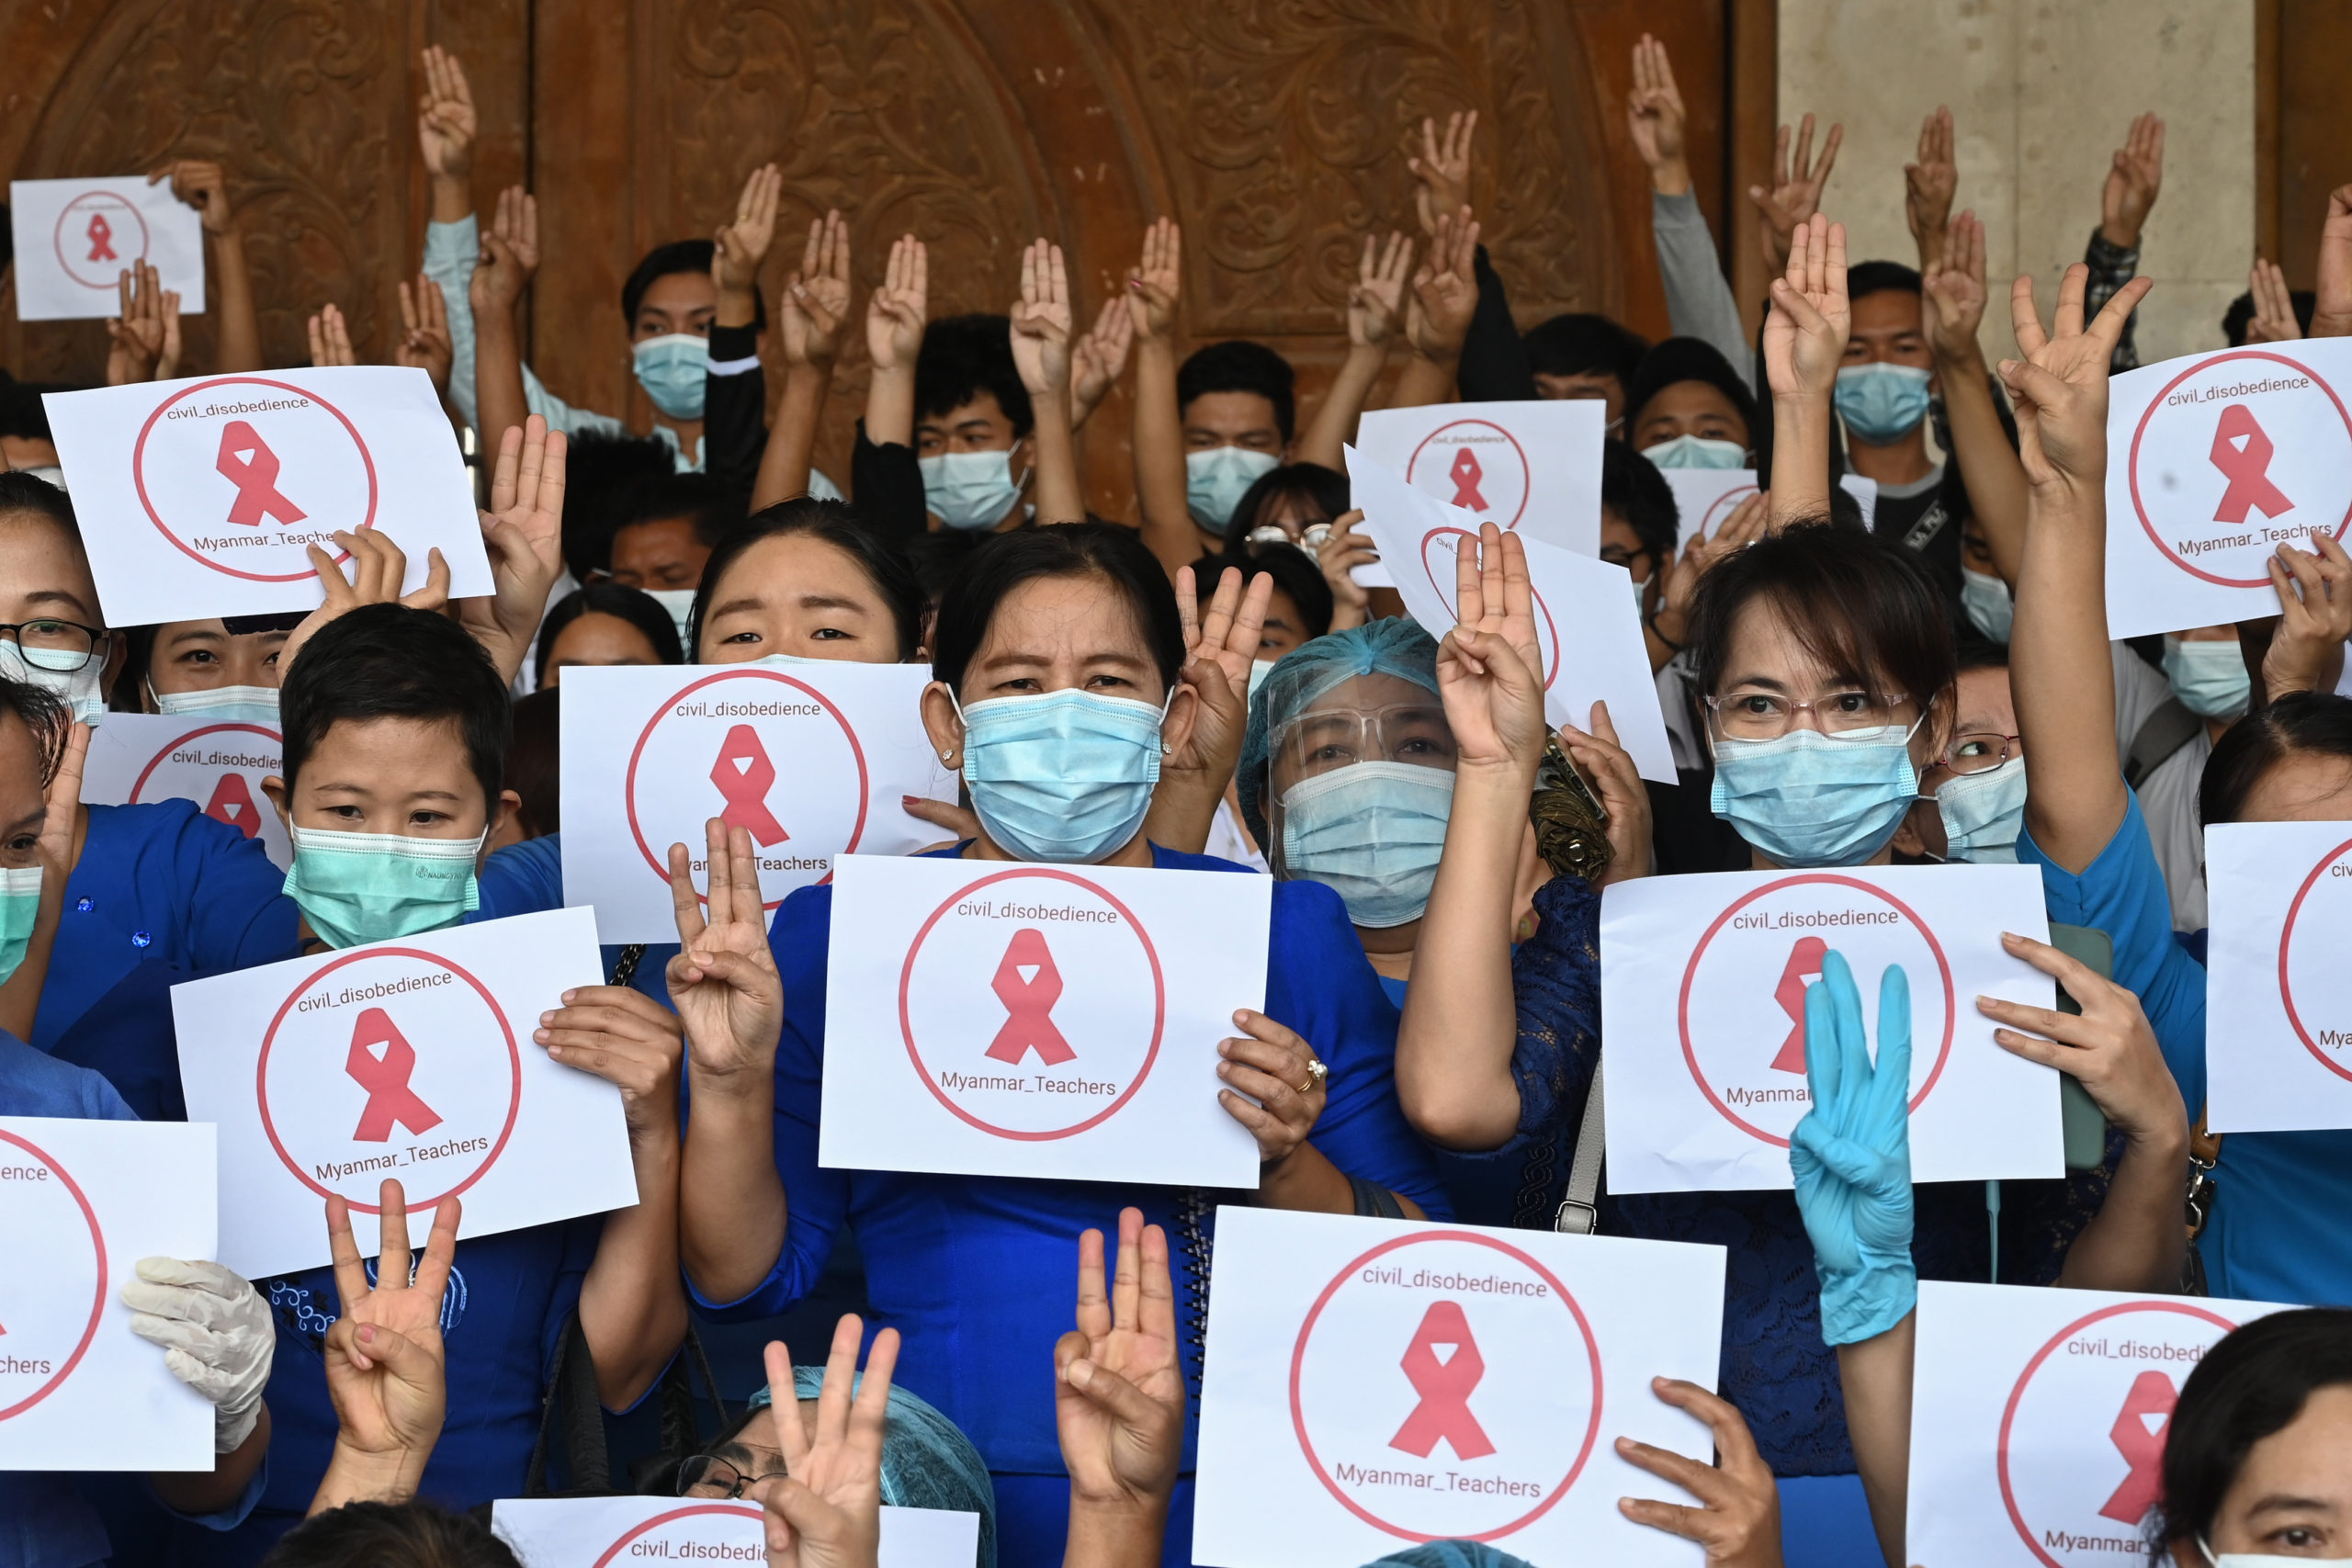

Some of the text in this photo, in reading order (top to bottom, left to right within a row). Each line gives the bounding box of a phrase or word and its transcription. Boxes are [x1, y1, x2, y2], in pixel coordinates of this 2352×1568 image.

[2167, 378, 2309, 406] civil_disobedience
[167, 399, 309, 420] civil_disobedience
[194, 531, 334, 552] Myanmar_Teache
[676, 702, 820, 717] civil_disobedience
[173, 750, 283, 769] civil_disobedie
[958, 901, 1117, 923] civil_disobedience
[1734, 909, 1898, 930] civil_disobedience
[299, 973, 452, 1012] civil_disobedience
[942, 1071, 1116, 1095] Myanmar_Teachers
[316, 1137, 488, 1181] Myanmar_Teachers
[1363, 1266, 1547, 1297] civil_disobedience
[2068, 1337, 2207, 1362] civil_disobedi
[1336, 1462, 1541, 1497] Myanmar_Teachers
[631, 1540, 767, 1561] civil_disobedi
[2045, 1530, 2152, 1555] Myanmar_
